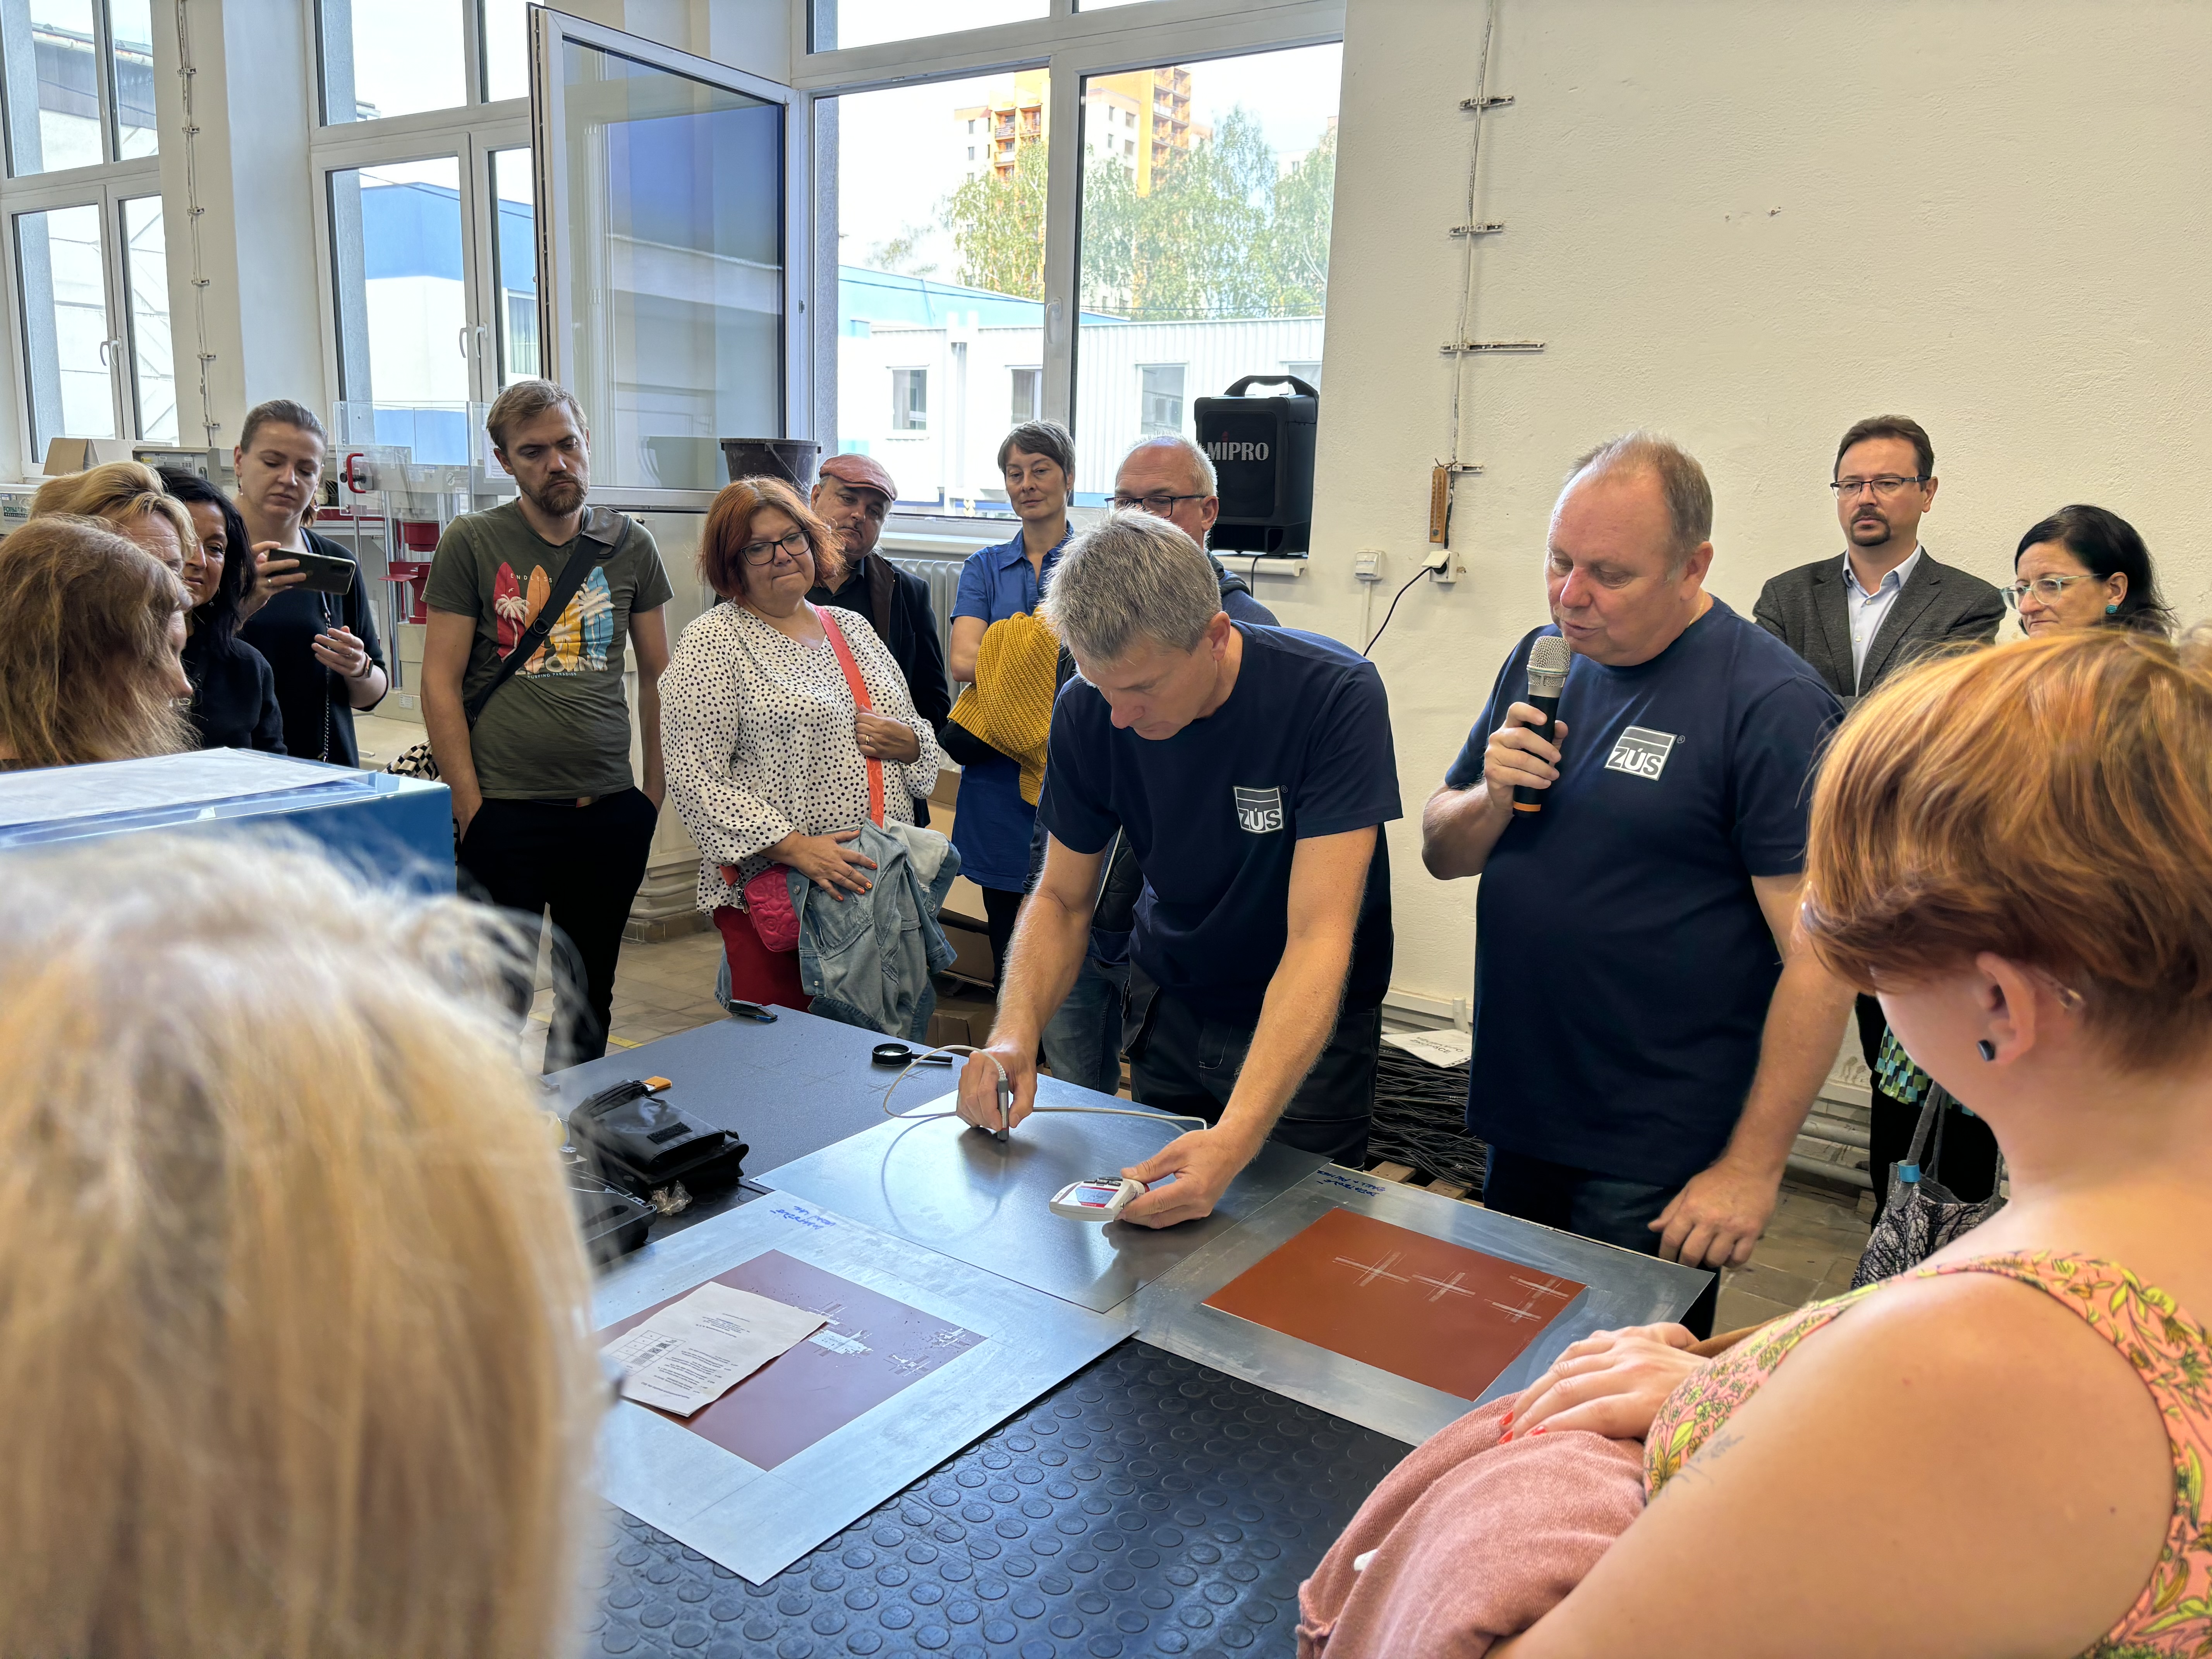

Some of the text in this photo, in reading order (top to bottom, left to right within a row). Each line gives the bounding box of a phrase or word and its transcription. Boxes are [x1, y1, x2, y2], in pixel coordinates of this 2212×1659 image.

[1207, 441, 1269, 460] MIPRO
[510, 573, 553, 583] ENDLESS
[1608, 747, 1662, 776] ZÚS
[1239, 808, 1281, 831] ZÚS
